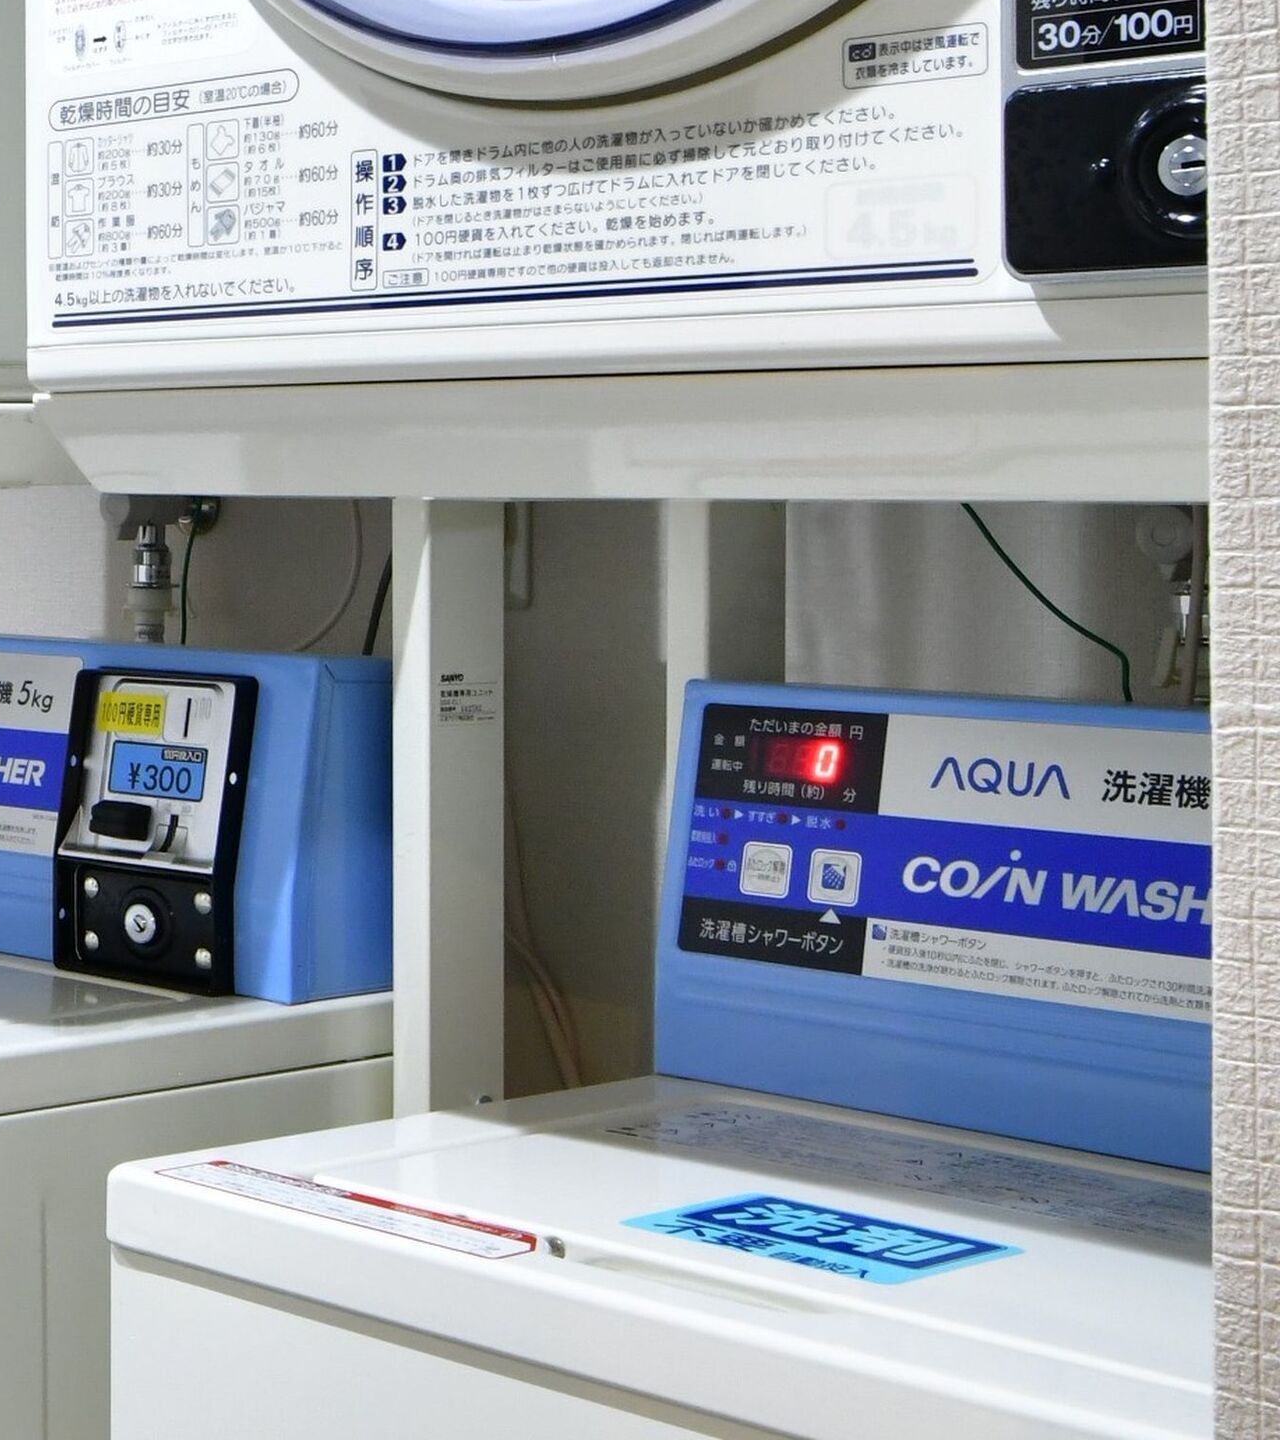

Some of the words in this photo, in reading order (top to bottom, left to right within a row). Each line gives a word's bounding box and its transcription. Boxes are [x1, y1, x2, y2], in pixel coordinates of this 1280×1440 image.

[1037, 9, 1194, 51] 30分/100円
[59, 89, 191, 126] 乾燥時間の目安
[298, 120, 338, 140] 約60分
[147, 139, 183, 157] 約30分
[298, 165, 338, 183] 約60分
[147, 181, 183, 198] 約30分
[147, 223, 183, 240] 約60分
[298, 209, 339, 227] 約60分
[354, 159, 374, 281] 操作順序
[388, 273, 423, 286] ご注意
[17, 680, 54, 713] 5kg
[749, 717, 842, 738] ただいまの金額
[849, 725, 864, 741] 円
[711, 758, 744, 772] 運転中
[814, 743, 839, 778] 0
[128, 762, 192, 794] ¥300
[931, 756, 1070, 800] AQUA
[1101, 769, 1212, 810] 洗濯機
[842, 788, 857, 803] 分
[902, 848, 1048, 906] COIN
[699, 916, 845, 956] 洗濯槽シャワーボタン
[890, 928, 987, 950] 洗濯槽シャワーボタン
[654, 1219, 786, 1253] 不要
[712, 1203, 976, 1261] 洗剤
